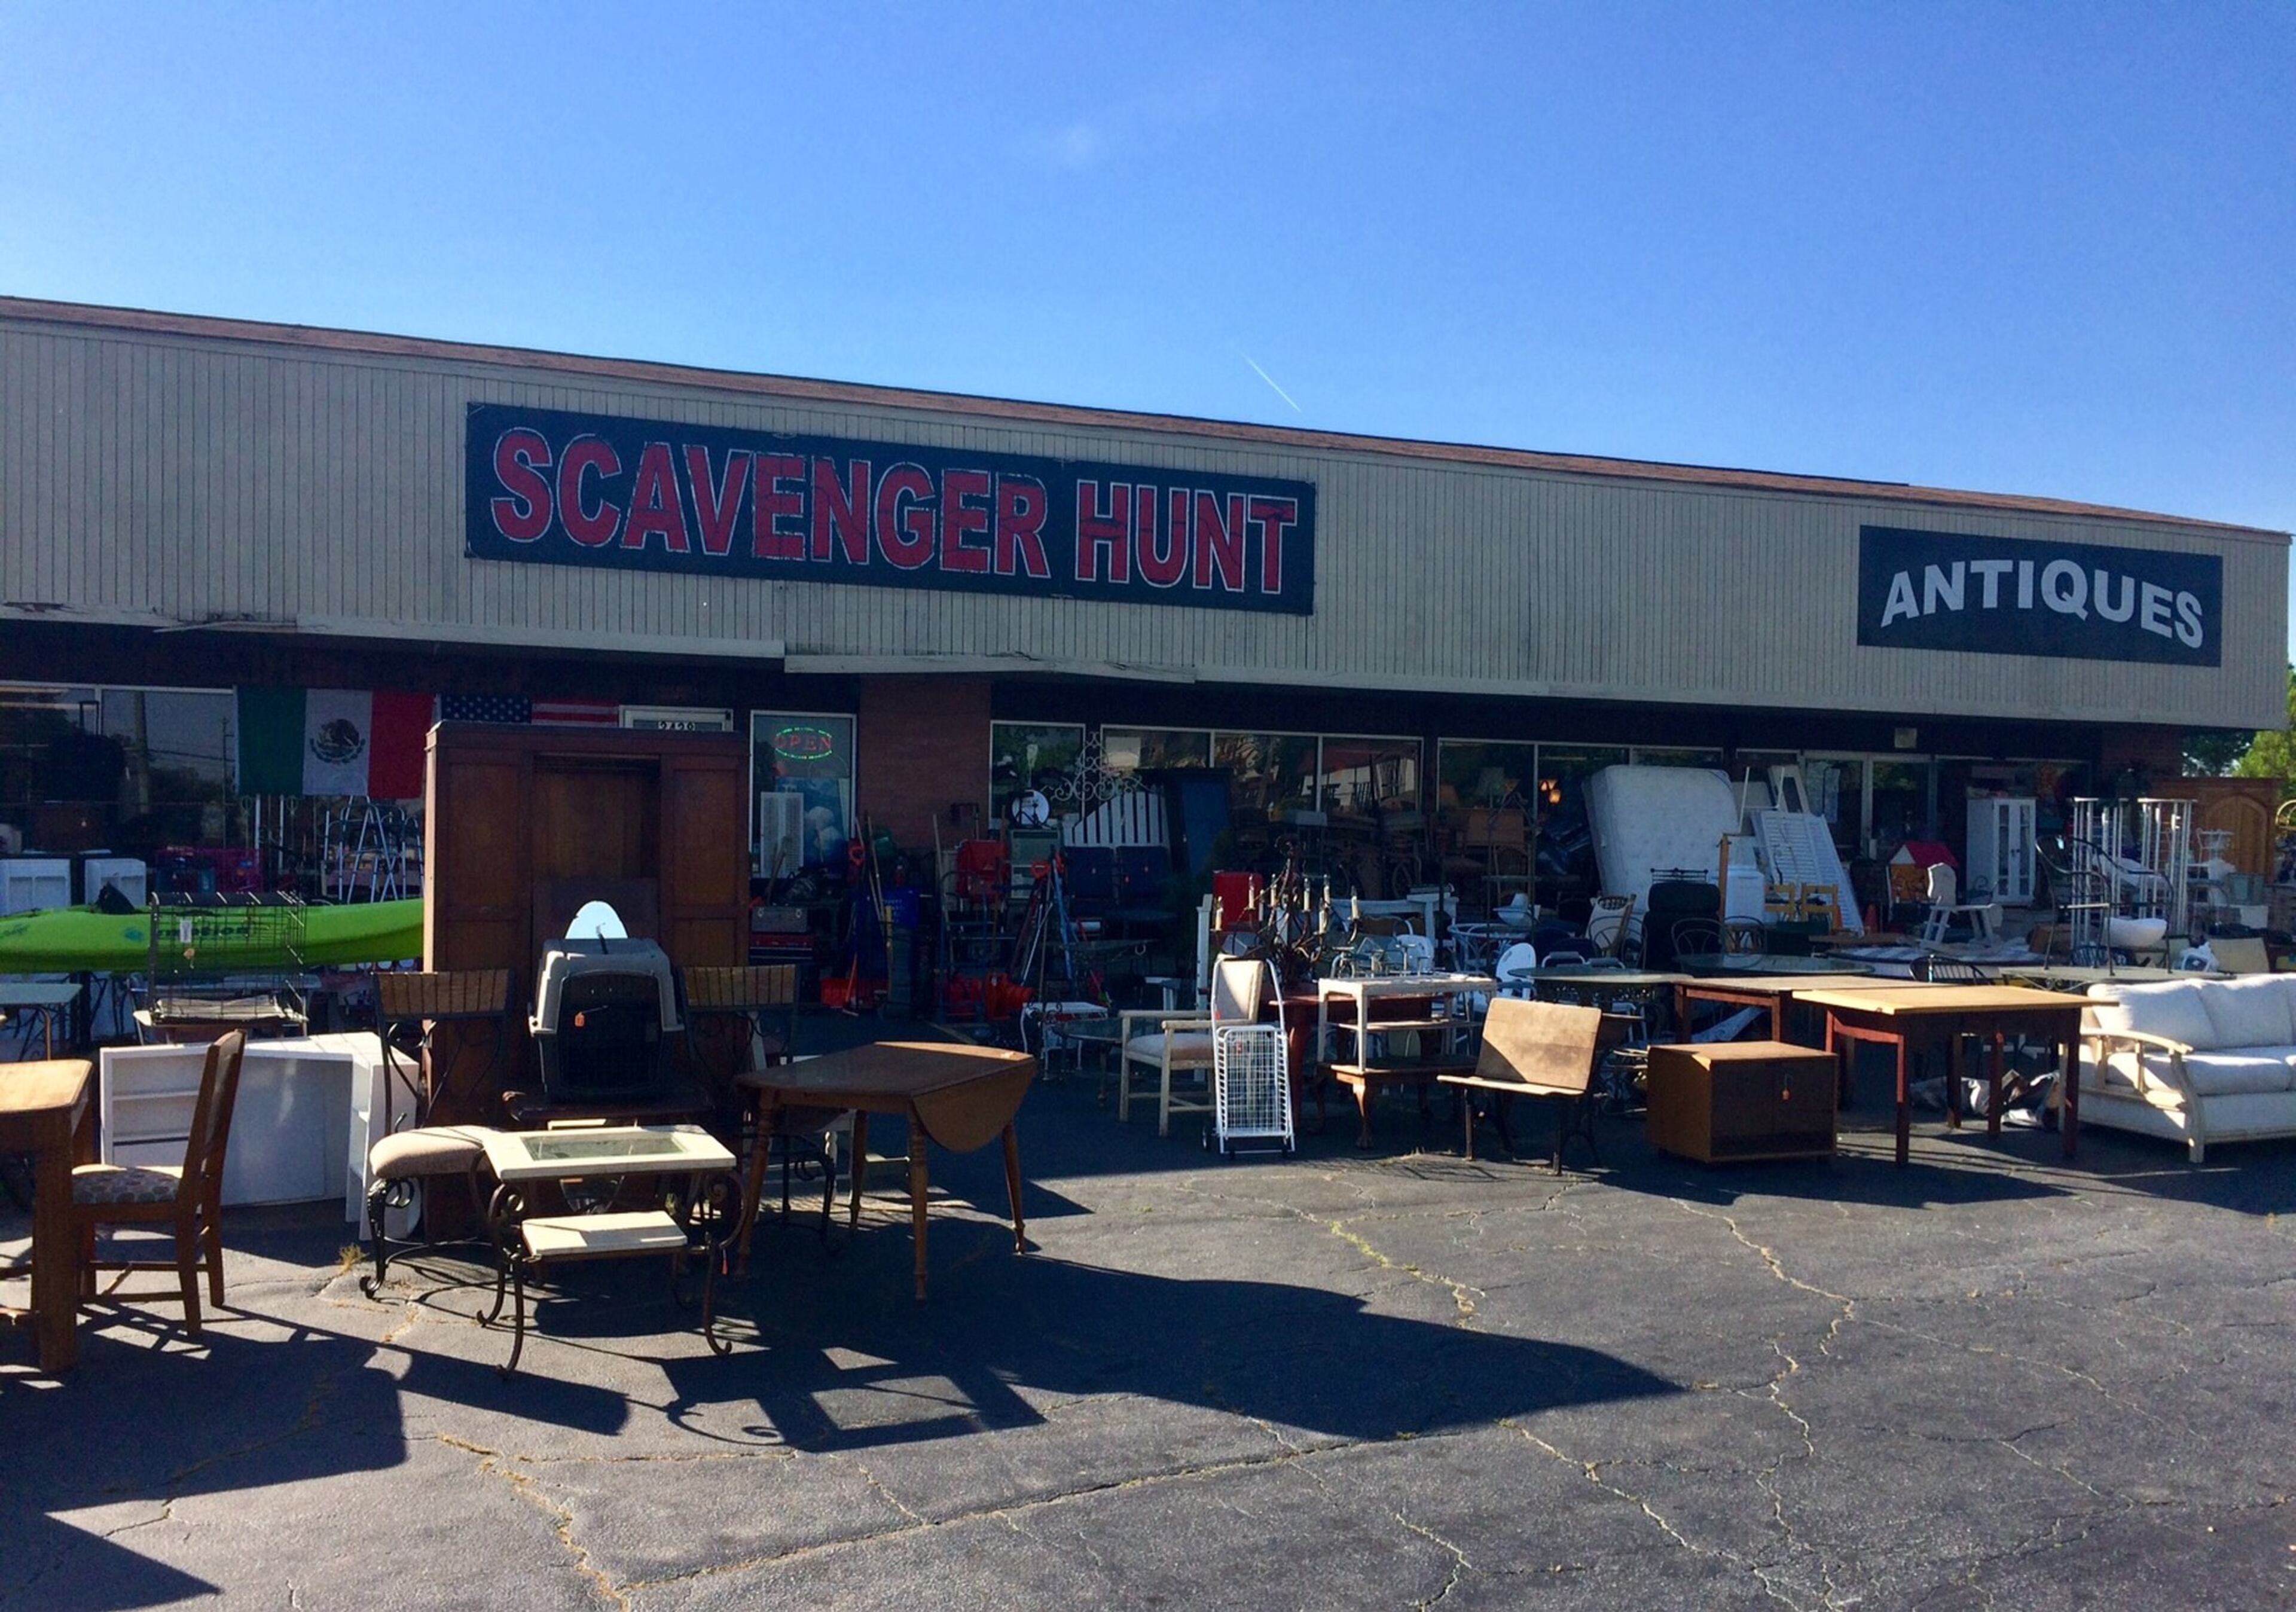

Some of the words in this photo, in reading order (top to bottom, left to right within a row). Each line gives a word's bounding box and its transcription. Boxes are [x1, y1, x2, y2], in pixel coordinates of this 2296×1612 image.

[490, 427, 1051, 579] SCAVENGER
[1076, 479, 1297, 594] HUNT
[1881, 559, 2204, 648] ANTIQUES
[774, 734, 832, 750] OPEN
